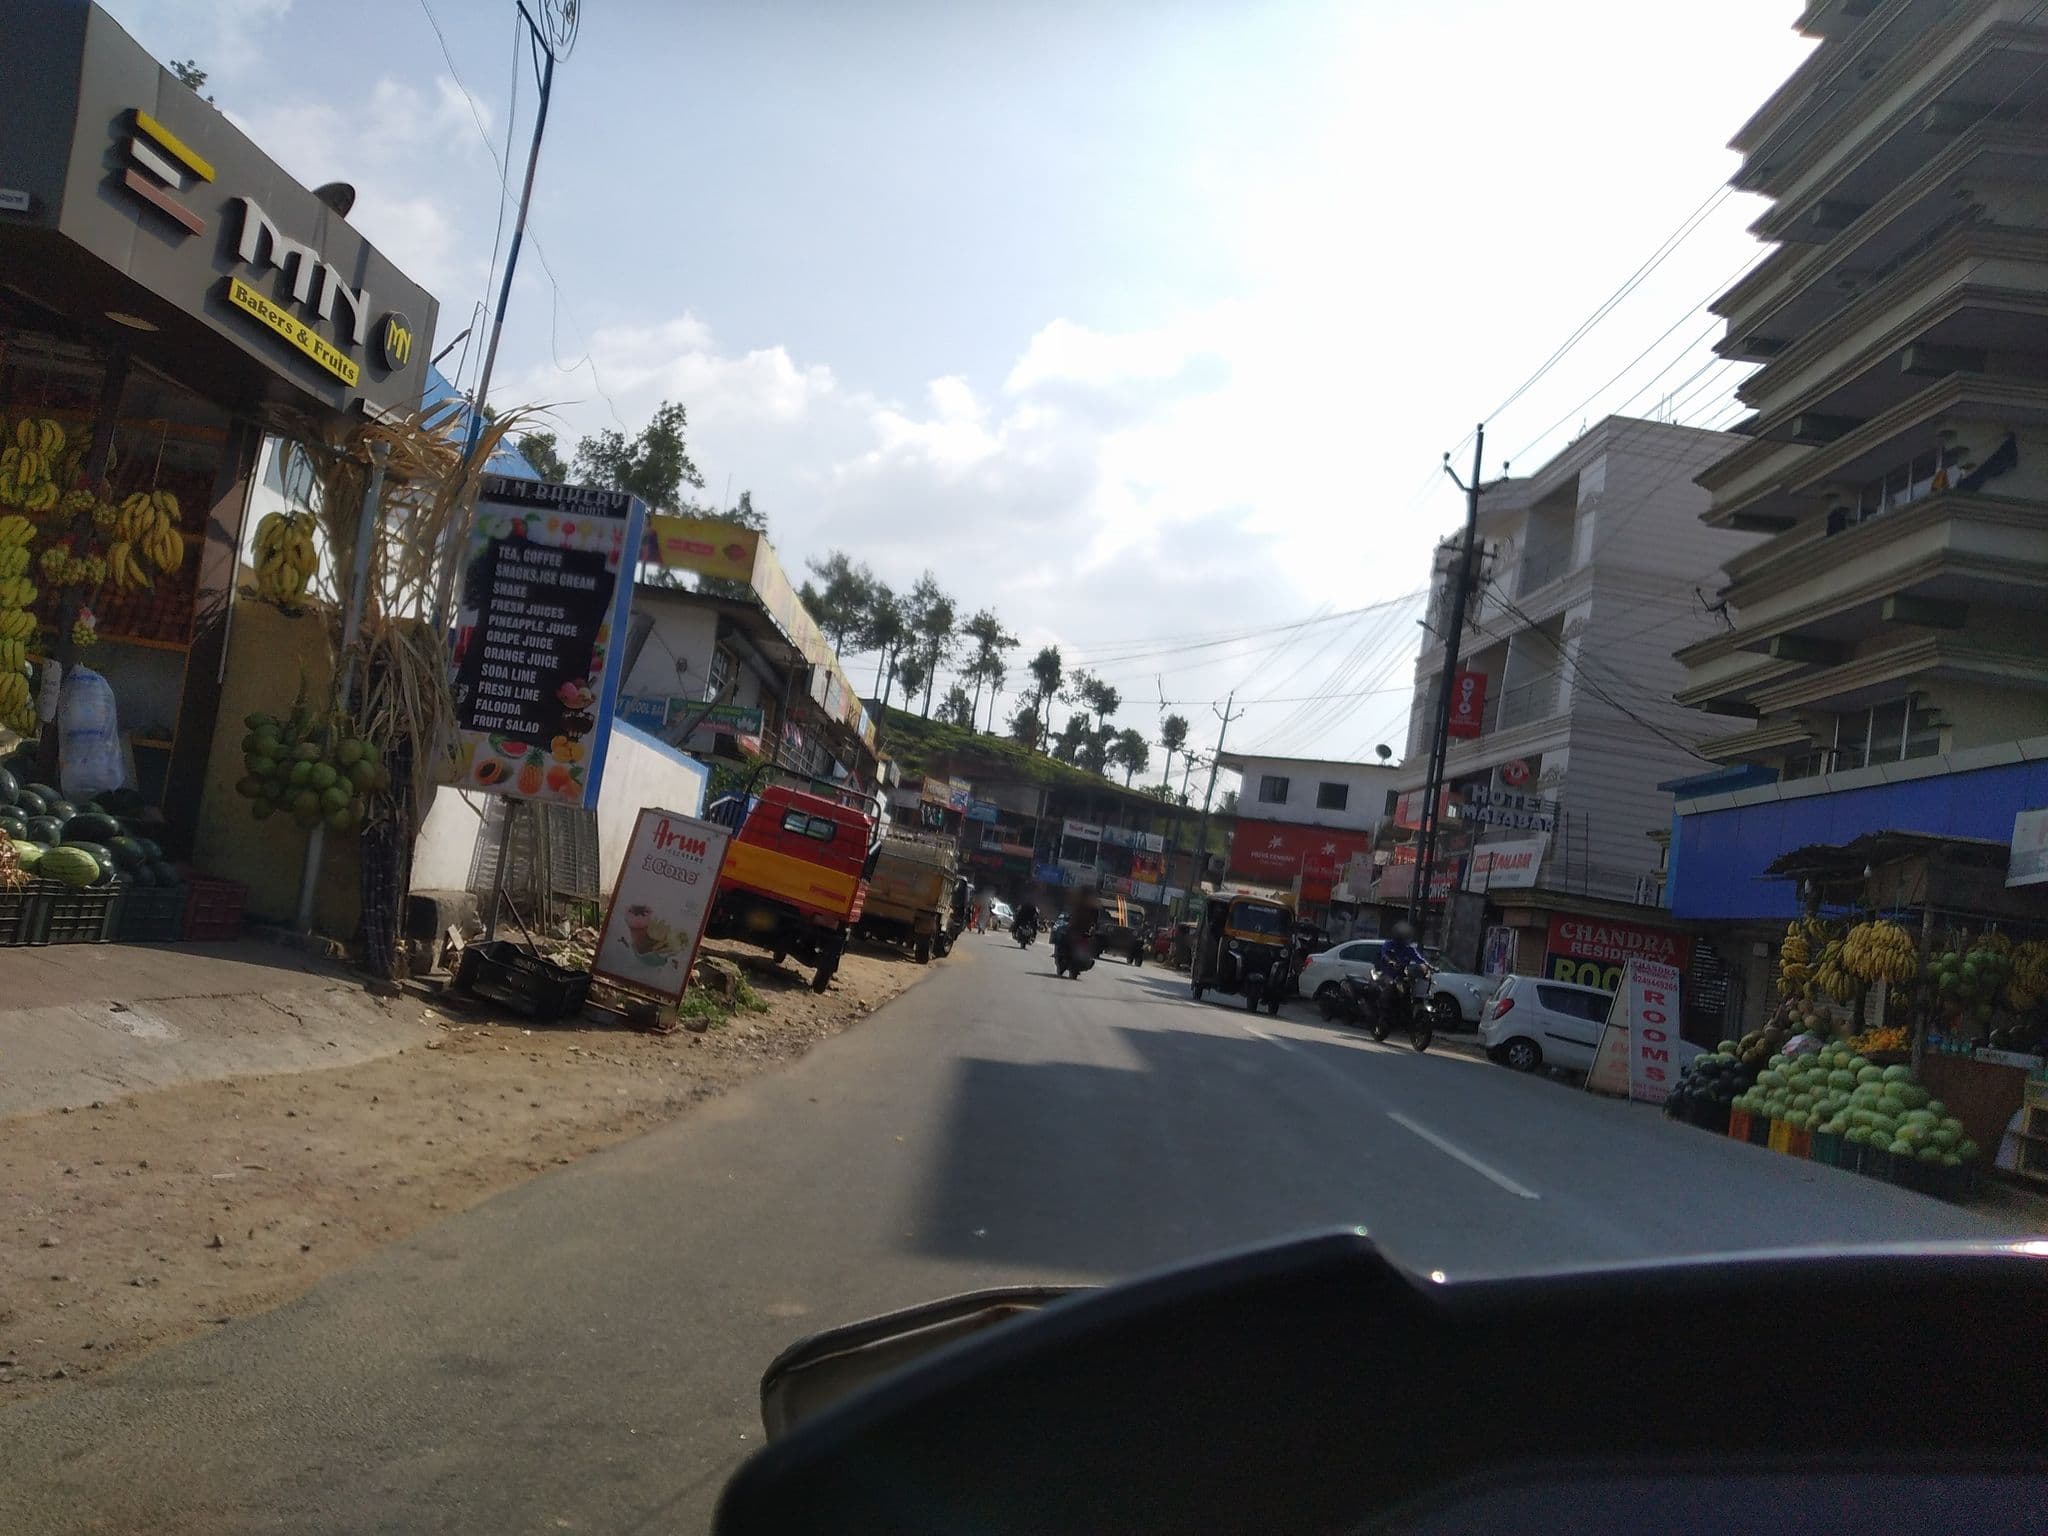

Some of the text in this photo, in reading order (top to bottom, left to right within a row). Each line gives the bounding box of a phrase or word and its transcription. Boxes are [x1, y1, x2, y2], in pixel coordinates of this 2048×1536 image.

[236, 285, 354, 380] Bakers & Fruits
[523, 549, 562, 567] COFFEE
[493, 582, 528, 598] SHAKE
[559, 573, 596, 591] CREAM
[491, 599, 565, 619] FRESH JUICES
[488, 615, 578, 637] PINEAPPLE JUICE
[486, 630, 554, 650] GRAPE JUICE
[484, 646, 559, 669] ORANGE JUICE
[481, 663, 537, 684] SODA LIME
[478, 681, 540, 702] FRESH LIME
[1459, 678, 1475, 714] OYO
[475, 698, 521, 715] FALOODA
[472, 714, 540, 734] FRUIT SALAD
[653, 817, 706, 856] Arun
[1559, 921, 1676, 955] CHANDRA
[1553, 958, 1623, 993] ROO
[1642, 989, 1669, 1082] ROOMS
